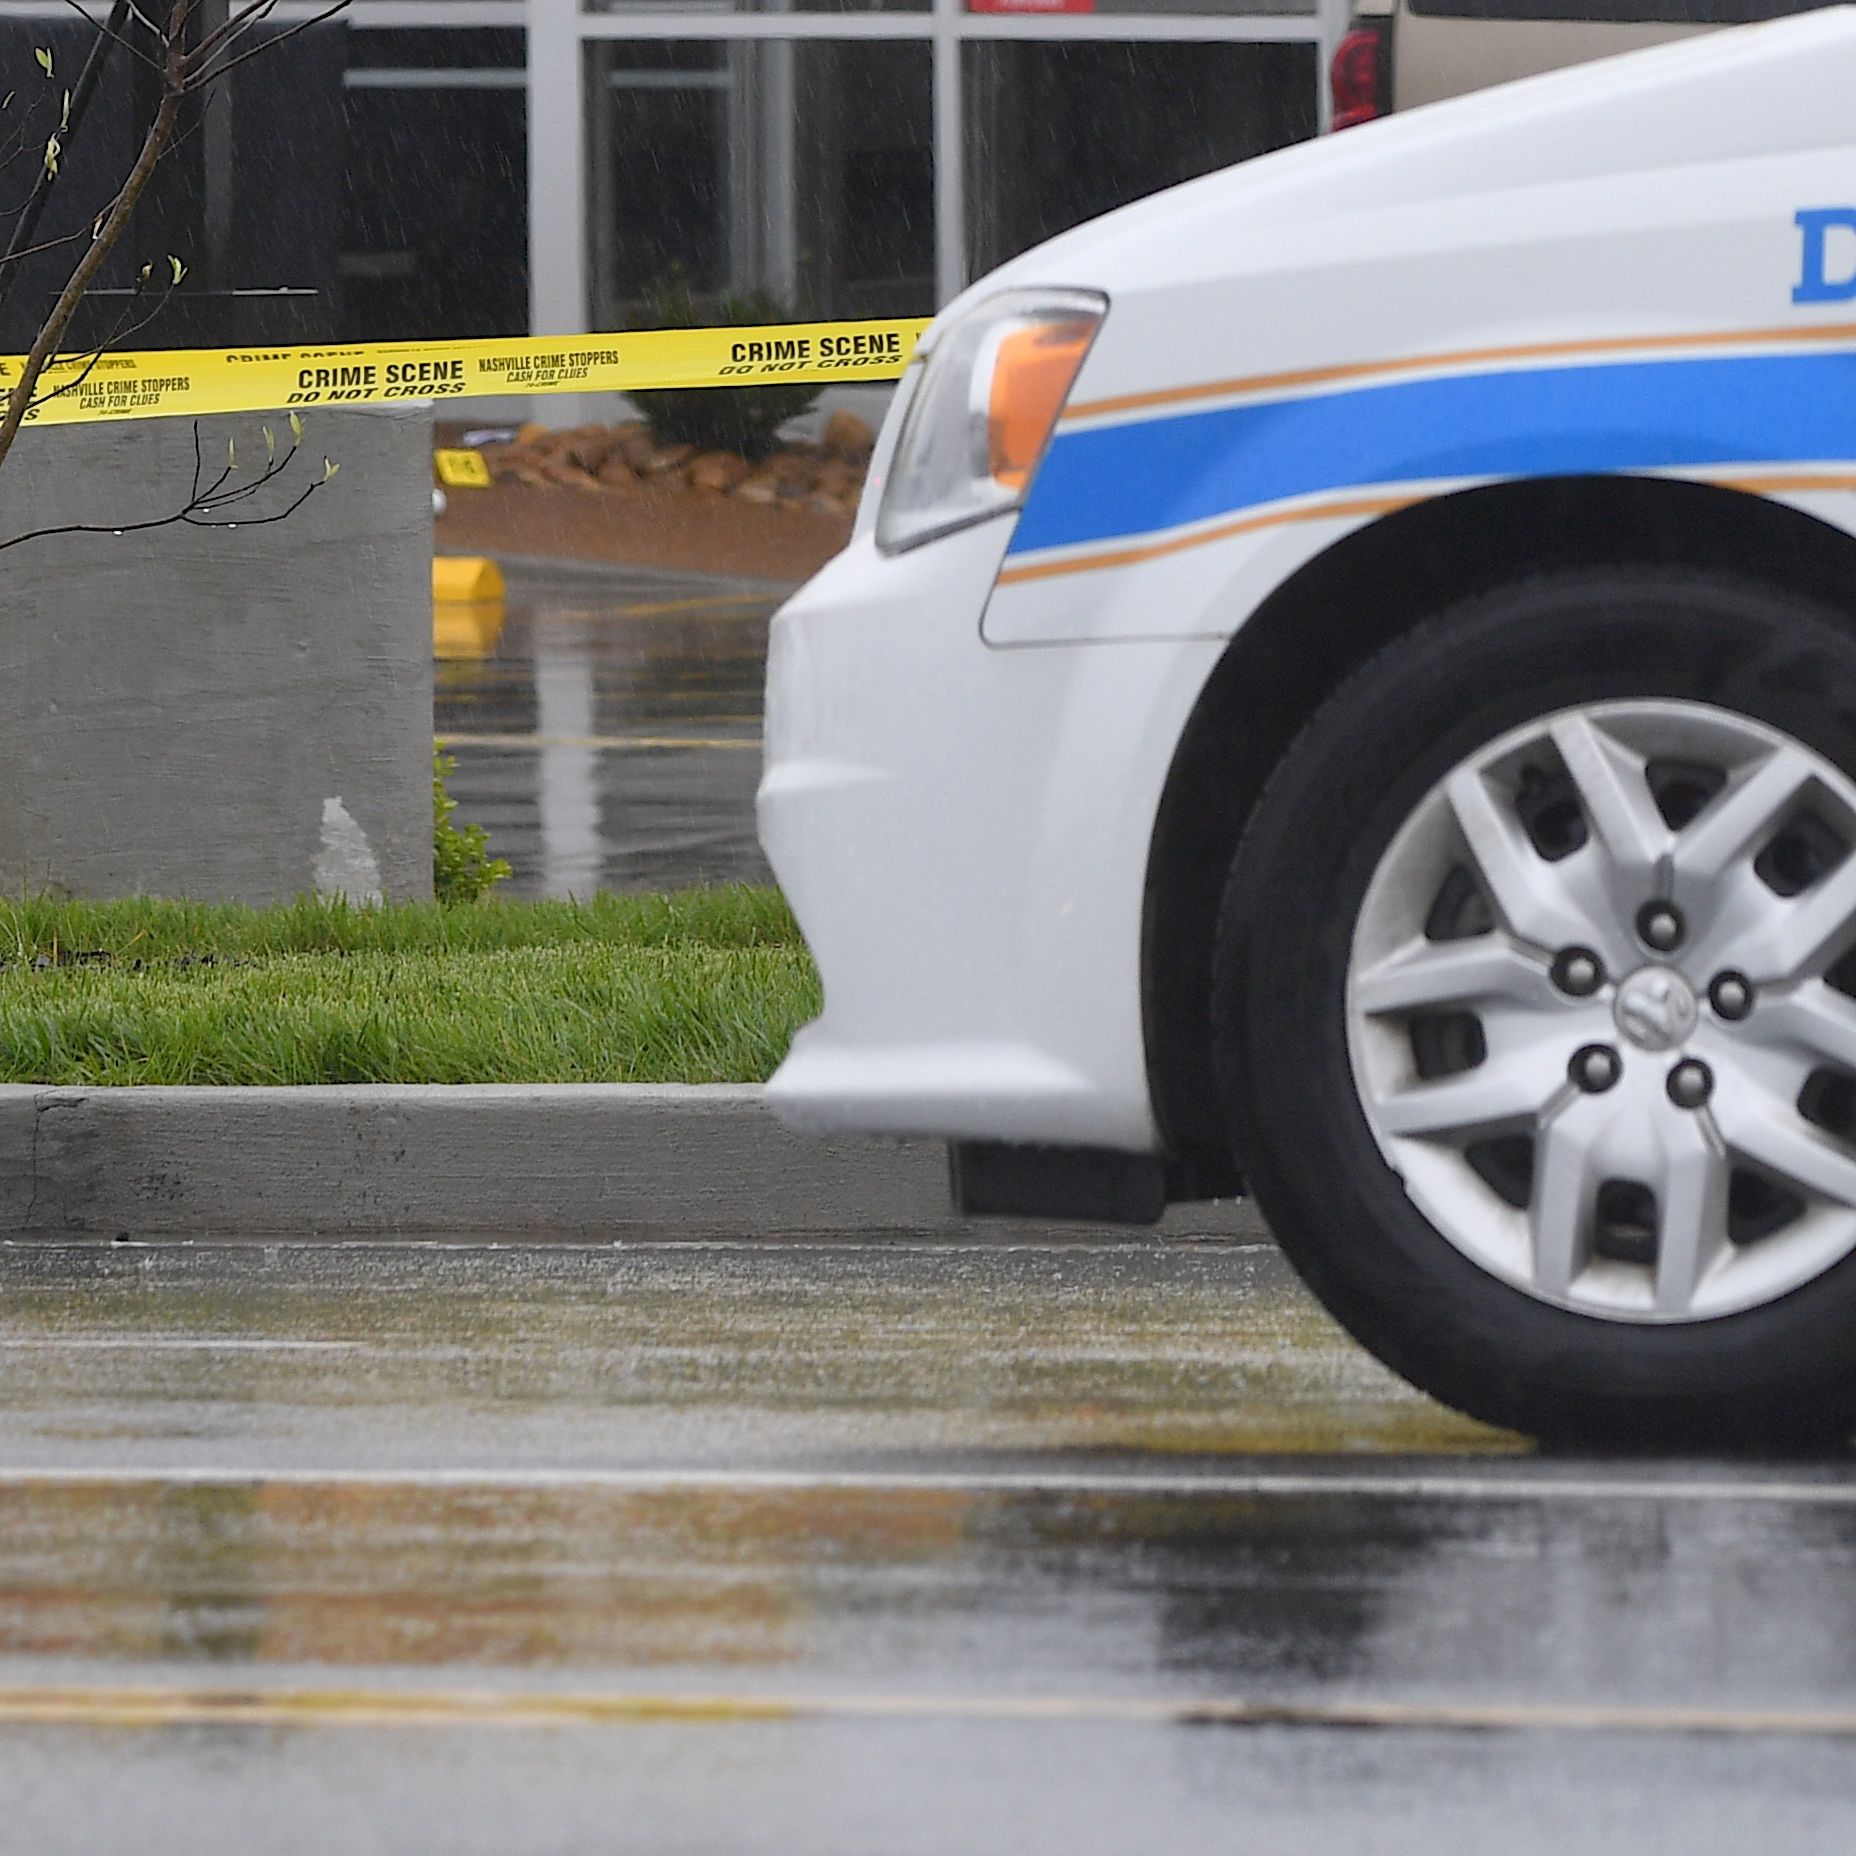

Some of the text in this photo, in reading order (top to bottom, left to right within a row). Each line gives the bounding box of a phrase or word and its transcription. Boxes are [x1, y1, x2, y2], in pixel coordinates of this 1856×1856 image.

[731, 333, 900, 362] CRIME SCENE
[479, 350, 619, 372] NASHVILLE CRIME STOPPERS
[718, 355, 902, 375] DO NOT CROSS
[299, 360, 464, 389] CRIME SCENE
[506, 367, 588, 383] CASH FOR CLUES
[53, 377, 190, 398] NASHVILLE CRIME STOPPERS
[286, 382, 467, 403] DO NOT CROSS
[79, 394, 160, 409] CASH FOR CLUES
